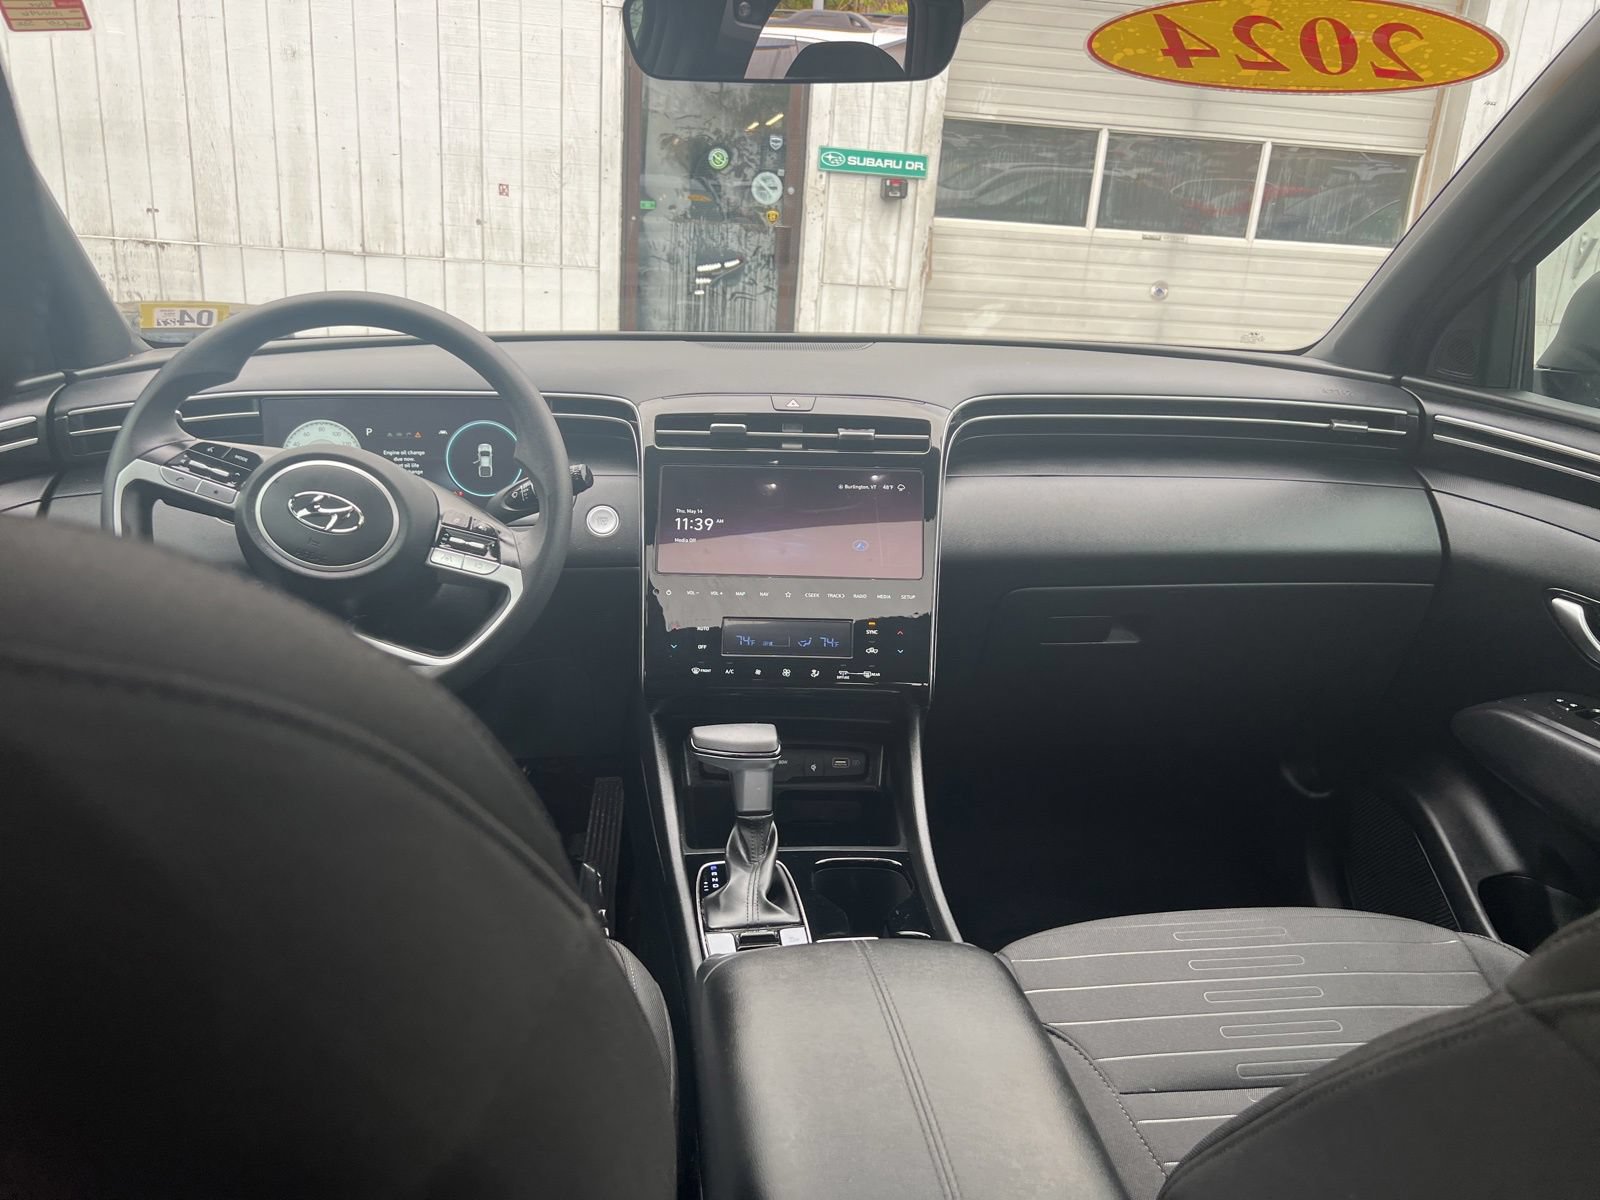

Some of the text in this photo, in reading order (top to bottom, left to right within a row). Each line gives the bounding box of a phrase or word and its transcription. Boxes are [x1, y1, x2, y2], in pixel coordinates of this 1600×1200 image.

[847, 156, 902, 169] SUBARU
[366, 428, 373, 436] P
[674, 517, 714, 531] 11:39
